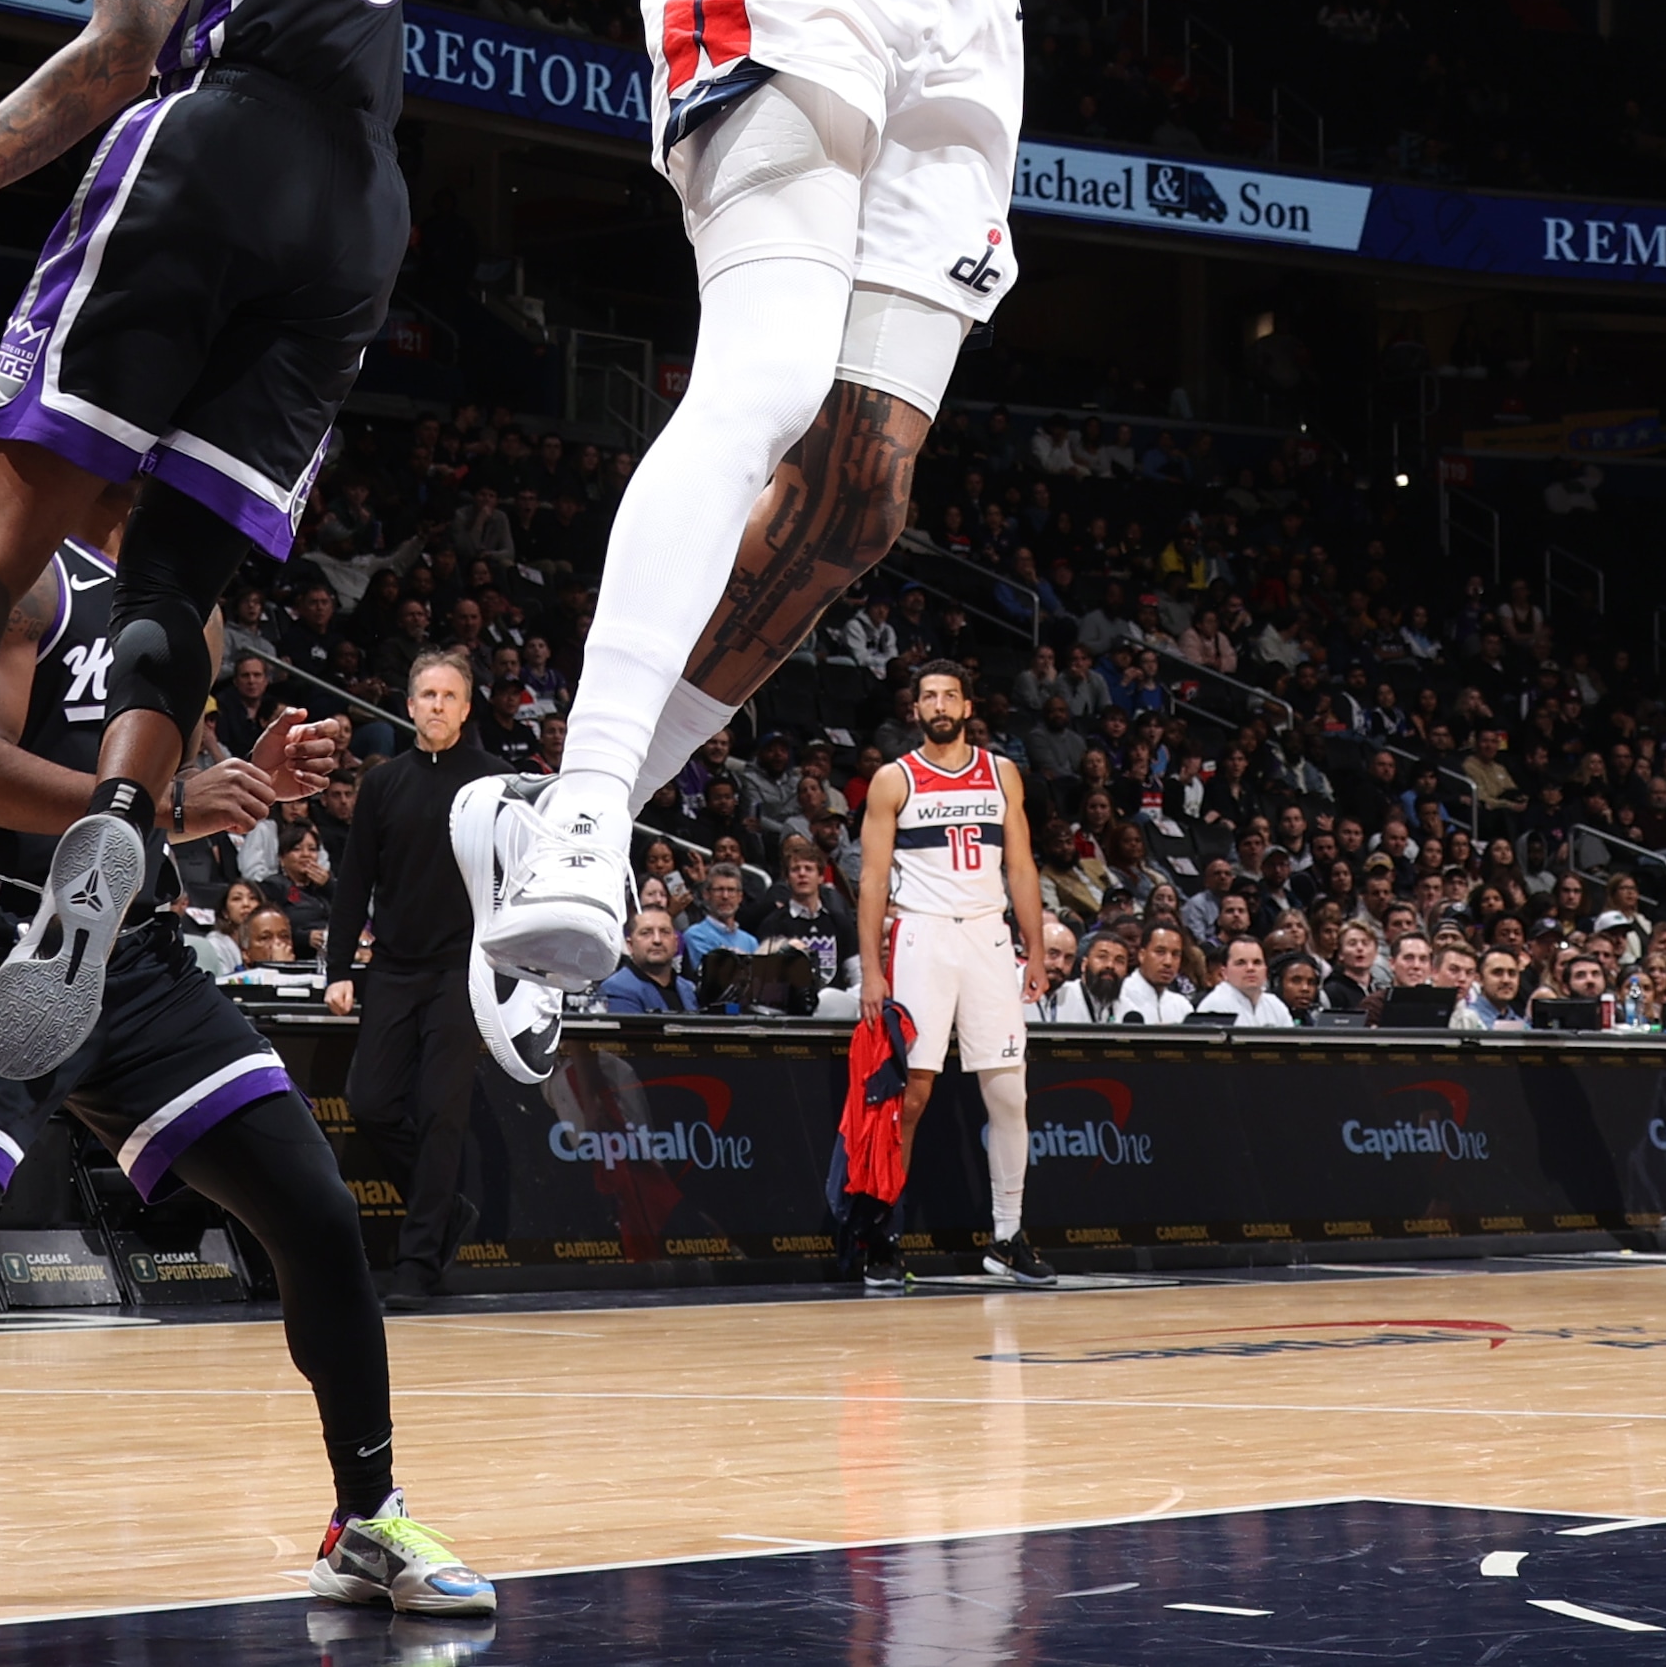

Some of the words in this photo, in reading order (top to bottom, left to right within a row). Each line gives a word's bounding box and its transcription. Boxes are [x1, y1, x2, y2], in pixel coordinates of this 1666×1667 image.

[1015, 156, 1134, 210] ichael
[1239, 192, 1311, 234] Son
[917, 799, 1000, 821] wizards
[944, 825, 982, 872] 16
[26, 1252, 73, 1263] CAESARS
[153, 1251, 198, 1263] CAESARS
[30, 1263, 107, 1282] SPORTSBOOK
[159, 1263, 233, 1283] SPORTSBOOK
